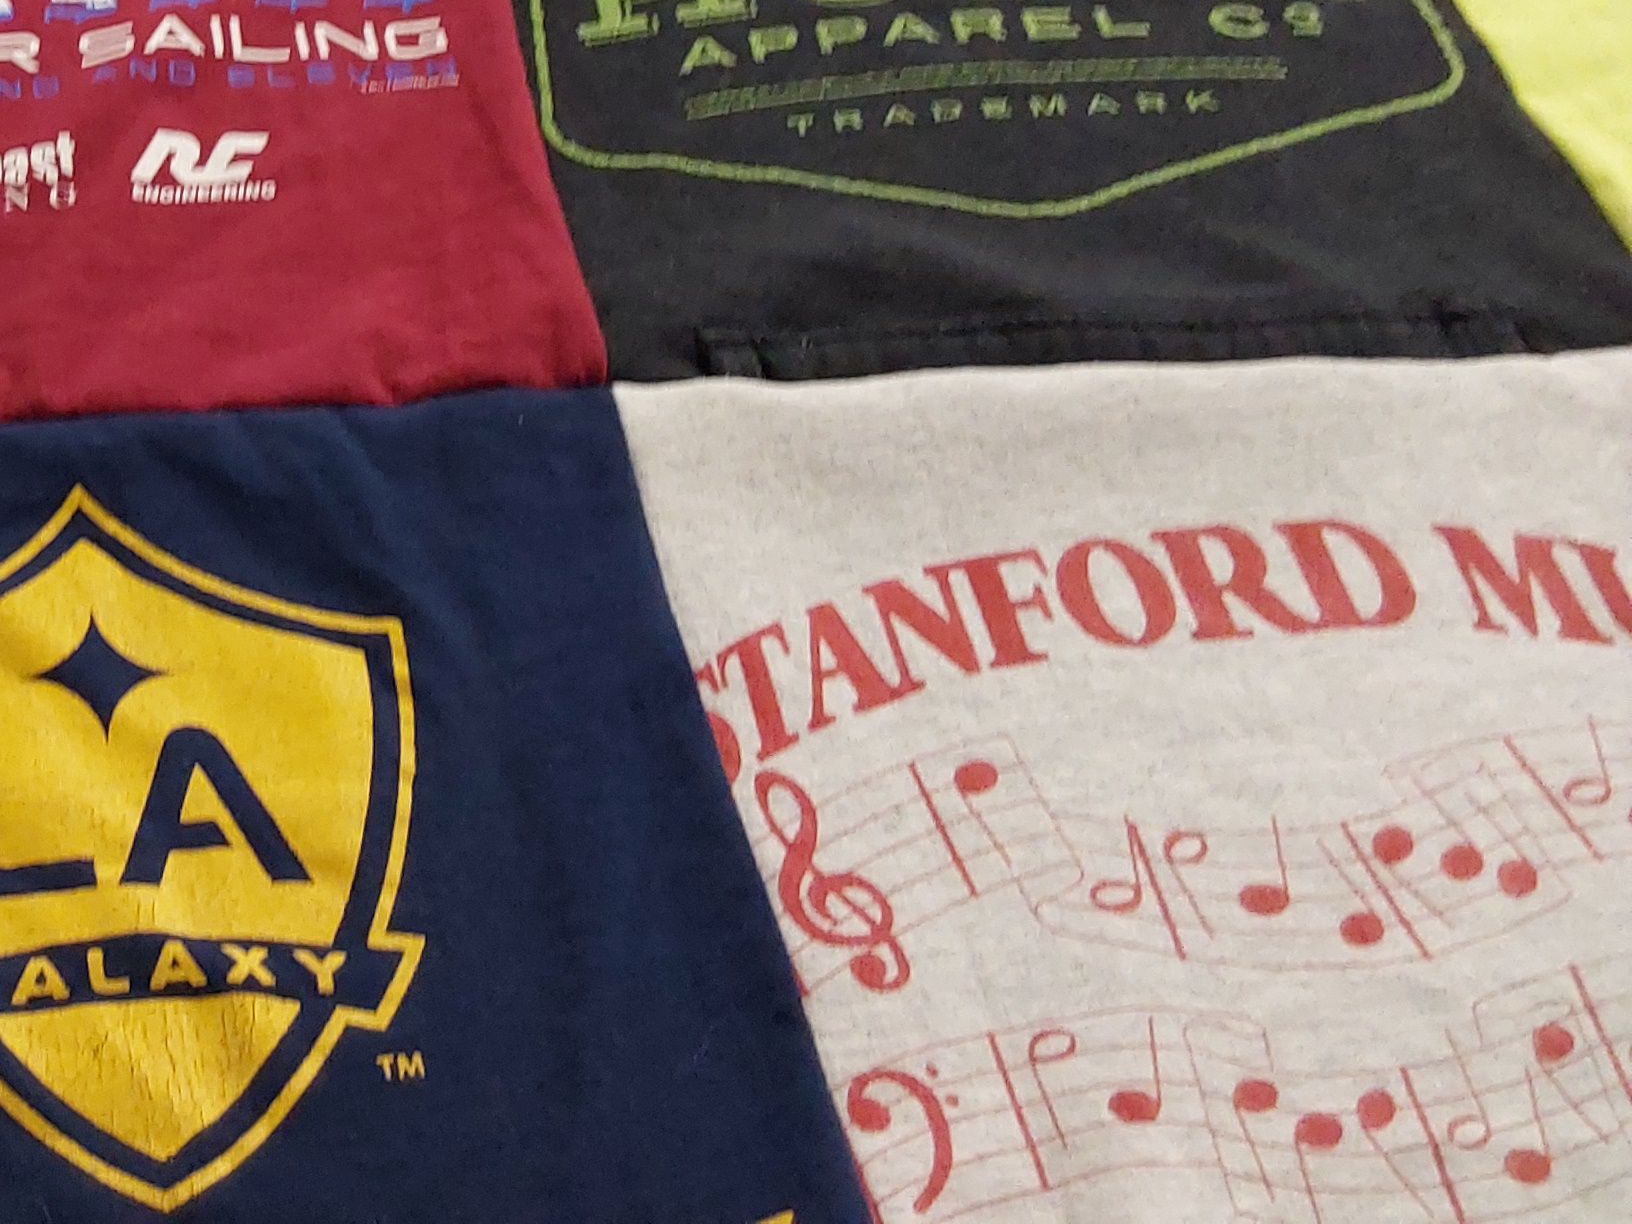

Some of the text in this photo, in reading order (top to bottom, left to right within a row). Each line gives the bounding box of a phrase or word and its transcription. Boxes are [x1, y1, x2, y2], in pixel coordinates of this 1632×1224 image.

[78, 14, 451, 70] SAILING
[679, 6, 1152, 77] APPAREL
[91, 55, 197, 87] AND
[786, 89, 1222, 138] TRADEMARK
[131, 178, 277, 206] ENGINEERING
[376, 1051, 428, 1082] TM
